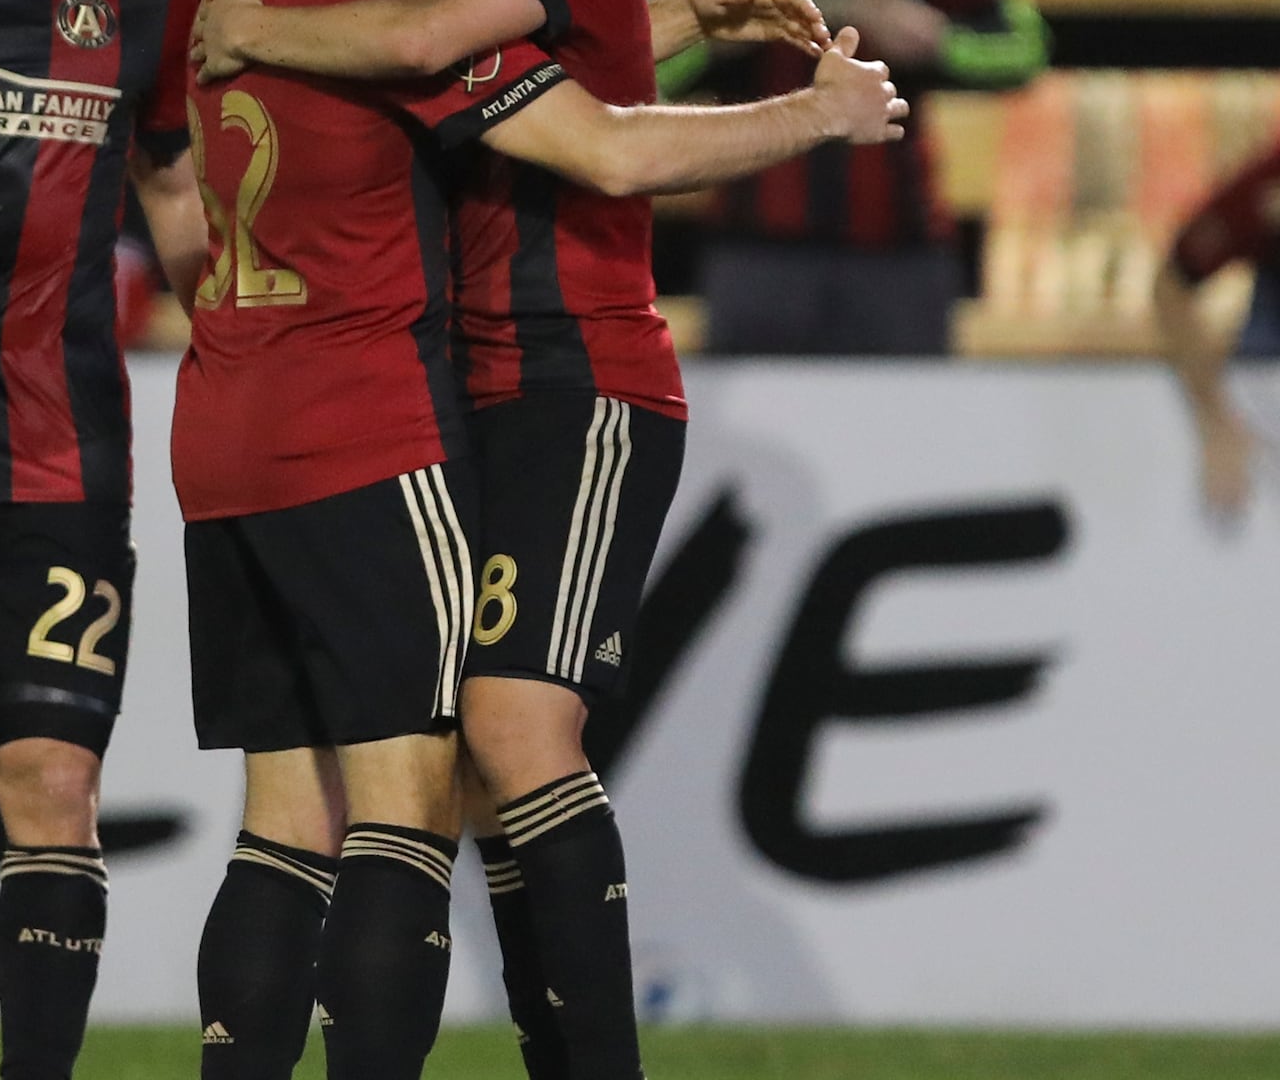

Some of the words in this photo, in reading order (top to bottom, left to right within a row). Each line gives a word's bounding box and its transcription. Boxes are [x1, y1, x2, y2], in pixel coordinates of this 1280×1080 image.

[31, 92, 116, 122] FAMILY
[481, 78, 538, 120] ATLANTA
[473, 553, 518, 646] 8
[27, 566, 122, 676] 22
[594, 649, 621, 668] adida
[18, 927, 62, 947] ATL
